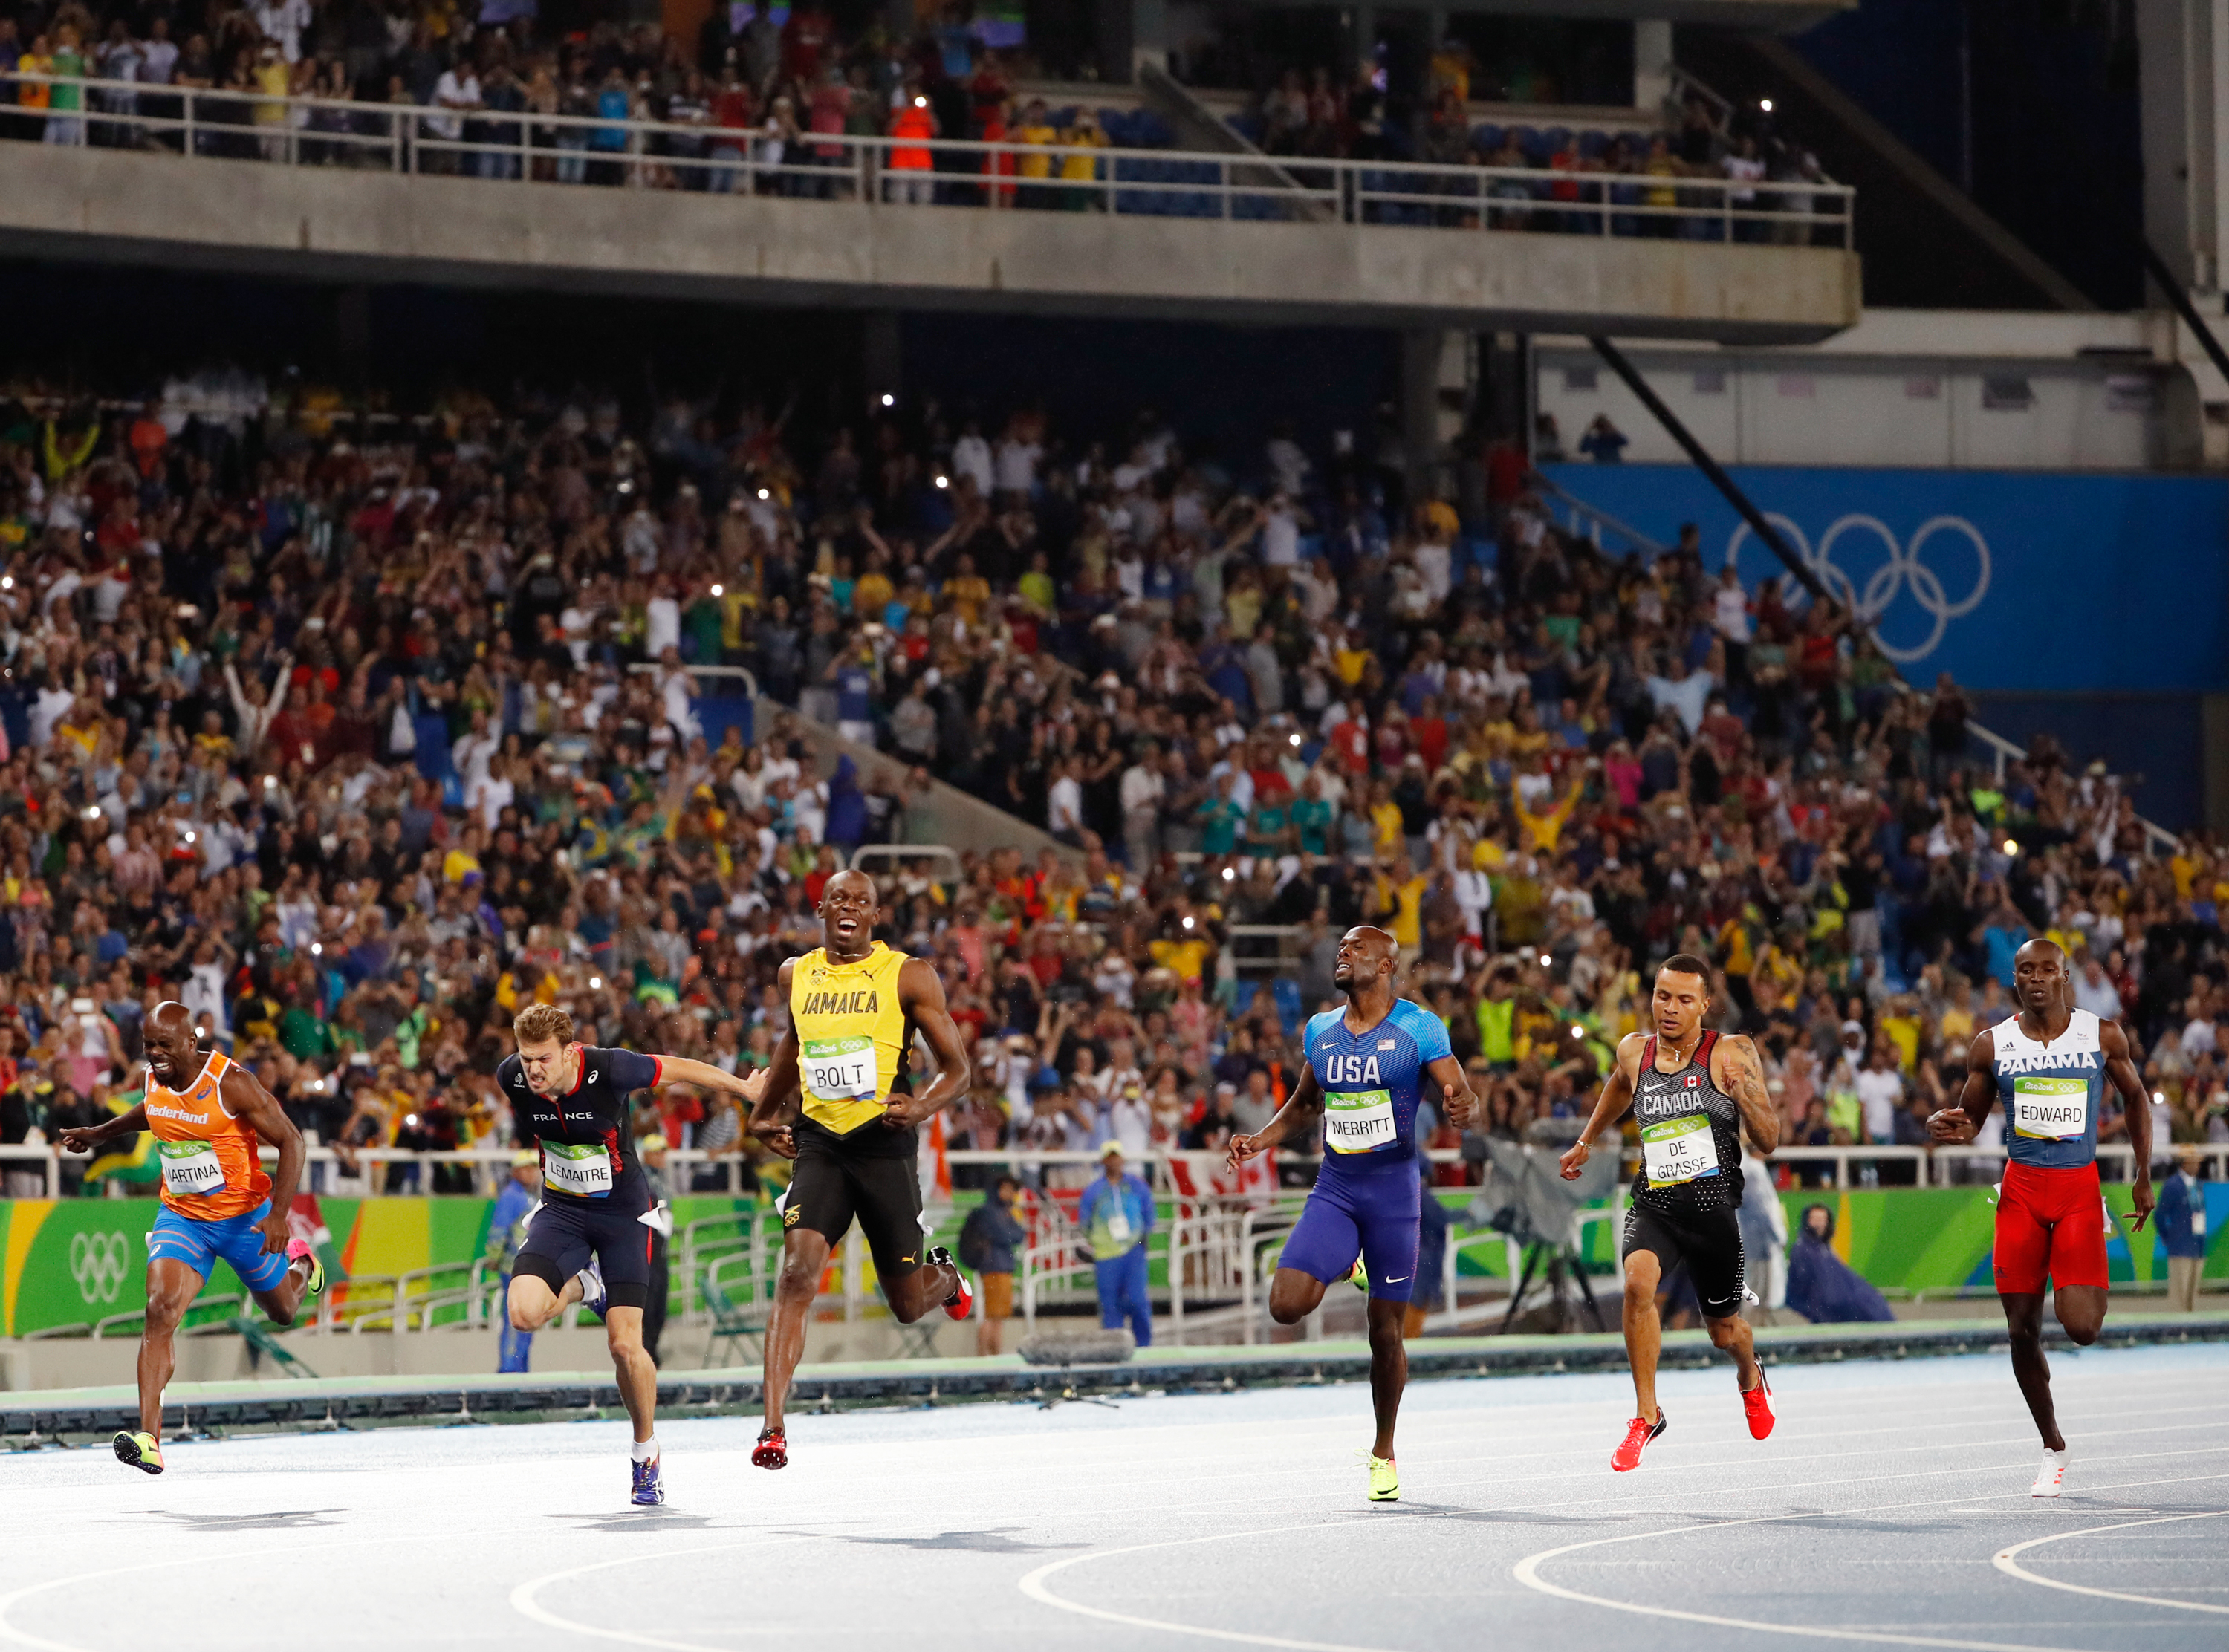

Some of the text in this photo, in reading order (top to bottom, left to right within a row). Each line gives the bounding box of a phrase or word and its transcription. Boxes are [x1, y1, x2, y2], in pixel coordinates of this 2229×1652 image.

[802, 990, 877, 1015] JAMAICA
[1326, 1055, 1382, 1085] USA
[1997, 1051, 2098, 1076] PANAMA
[815, 1064, 864, 1088] BOLT
[2025, 1082, 2054, 1091] Rio2016
[1331, 1097, 1357, 1106] Rio2016
[1643, 1090, 1706, 1115] CANADA
[146, 1104, 209, 1125] Nederland
[533, 1111, 594, 1122] FRANCE
[2021, 1105, 2082, 1122] EDWARD
[1332, 1116, 1389, 1136] MERRITT
[1649, 1126, 1675, 1138] Rio2016
[1669, 1140, 1688, 1157] DE
[164, 1164, 218, 1183] MARTINA
[551, 1162, 609, 1183] LEMAITRE
[1658, 1156, 1709, 1180] GRASSE
